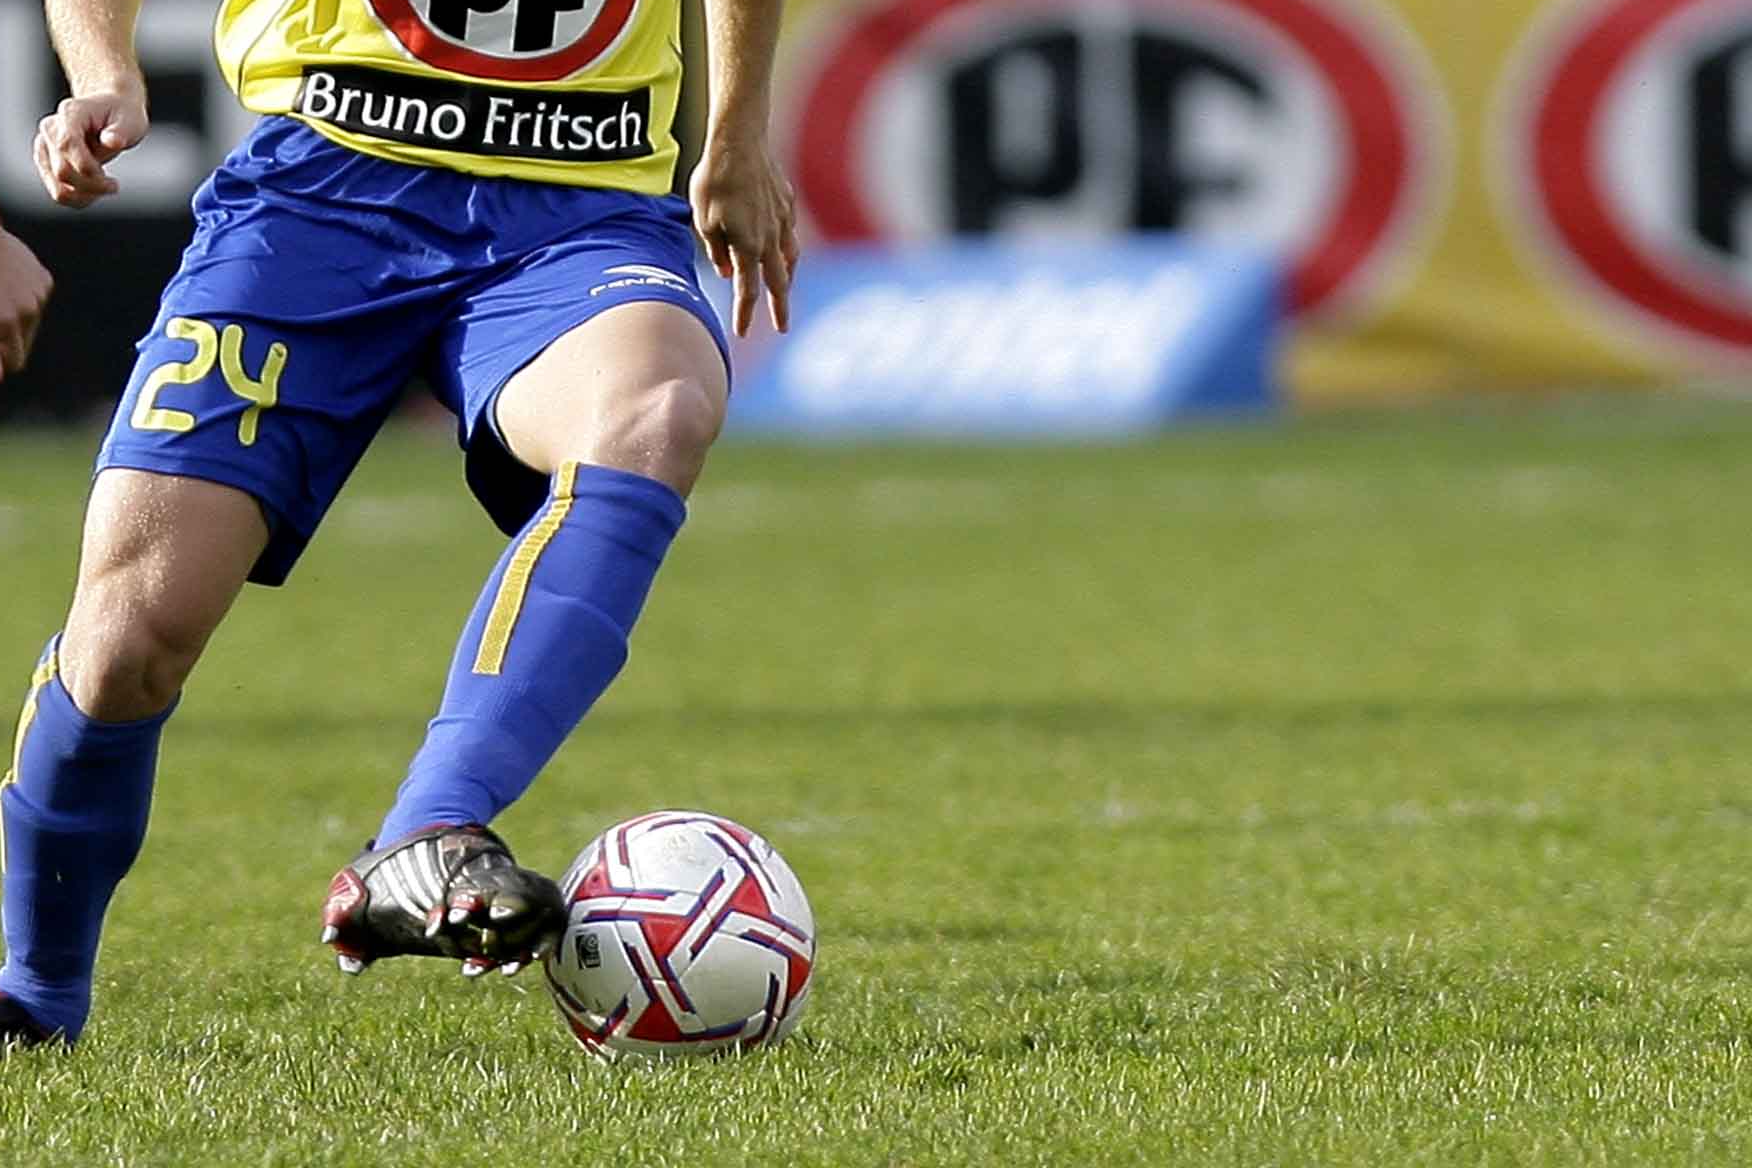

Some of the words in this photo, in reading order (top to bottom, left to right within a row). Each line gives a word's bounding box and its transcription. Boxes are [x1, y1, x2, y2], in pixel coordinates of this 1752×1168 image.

[301, 71, 467, 140] Bruno
[481, 96, 642, 151] Fritsch
[938, 12, 1273, 236] PF
[130, 317, 288, 447] 24
